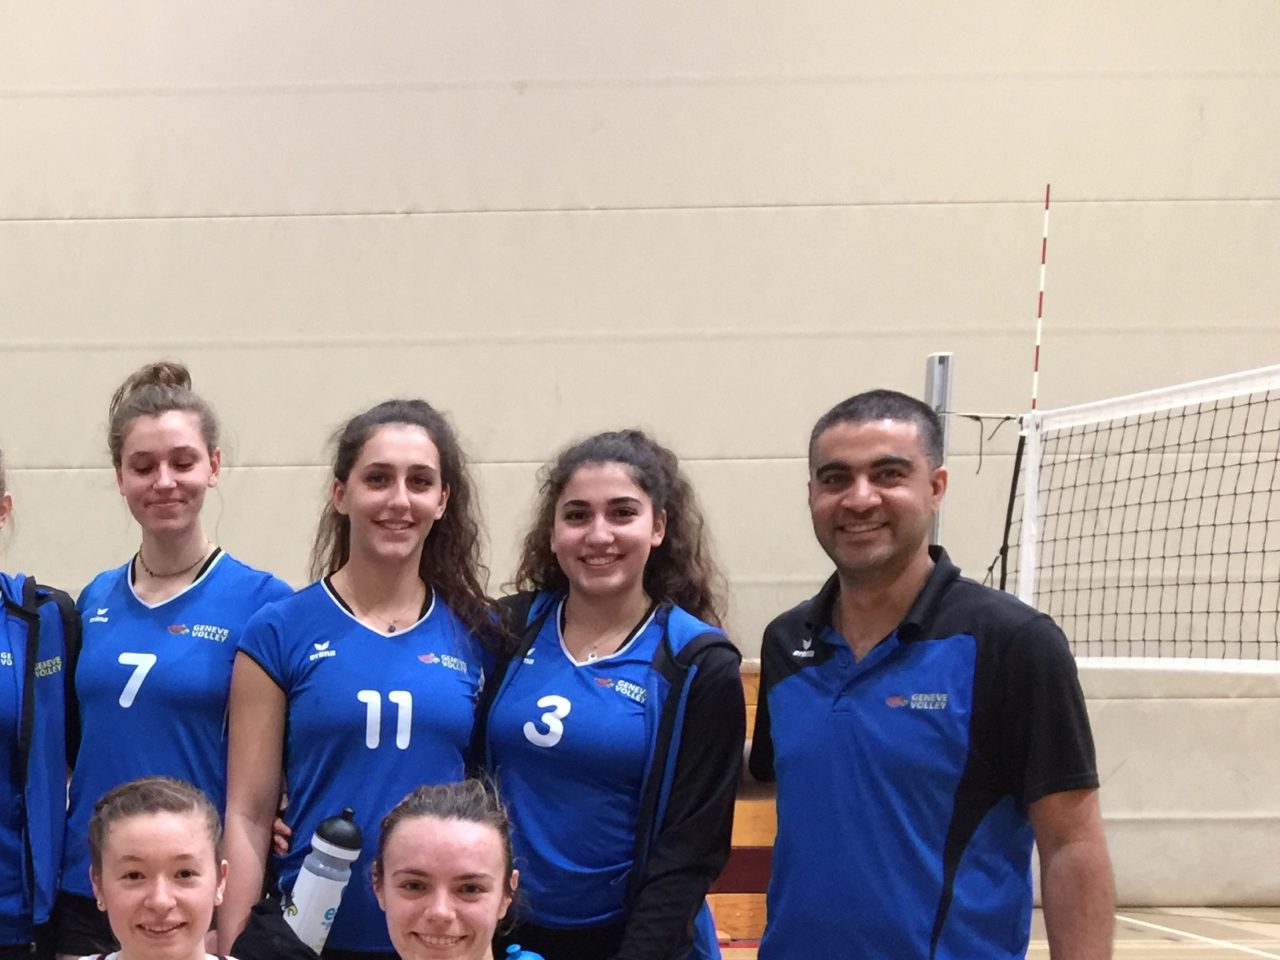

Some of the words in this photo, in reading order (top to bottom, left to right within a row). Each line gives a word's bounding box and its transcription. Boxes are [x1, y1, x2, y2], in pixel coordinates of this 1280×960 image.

[193, 624, 230, 635] GENEVE
[192, 630, 228, 643] VOLLEY
[310, 650, 336, 661] erima
[35, 664, 62, 678] VOLLEY
[117, 652, 158, 709] 7
[911, 694, 948, 703] GENEVE
[910, 701, 946, 710] VOLLEY
[357, 689, 413, 750] 11
[523, 694, 572, 748] 3
